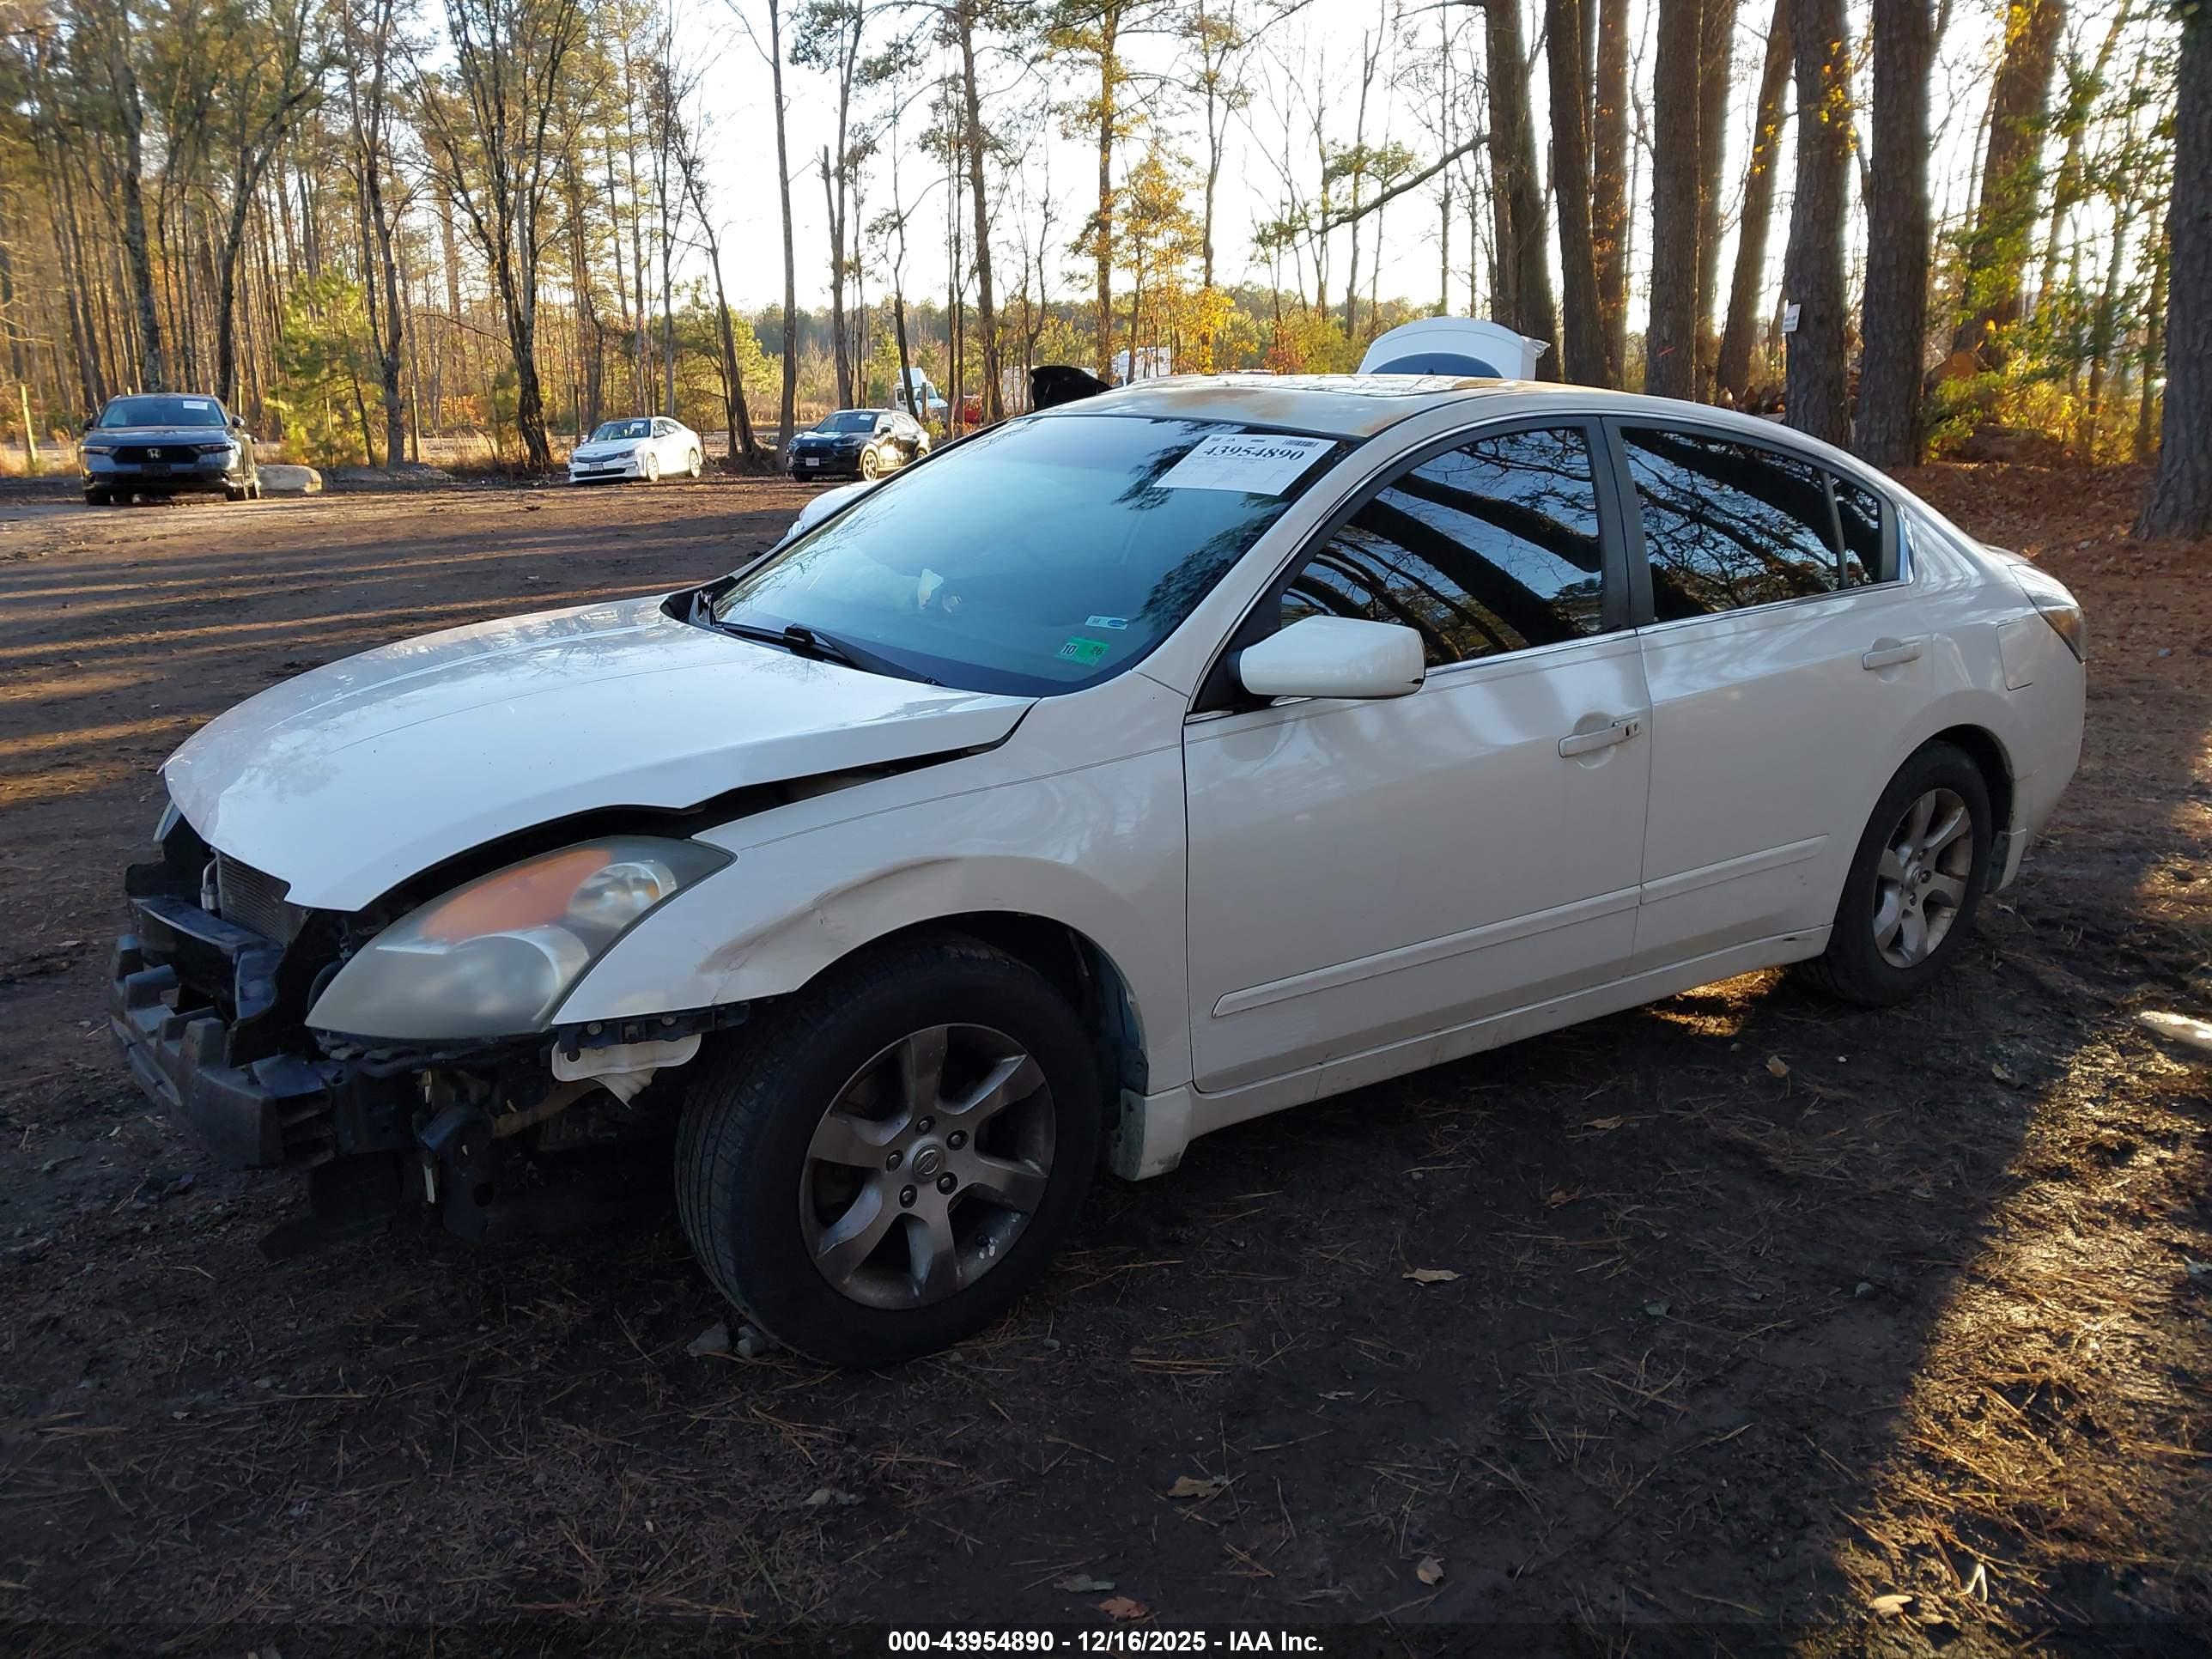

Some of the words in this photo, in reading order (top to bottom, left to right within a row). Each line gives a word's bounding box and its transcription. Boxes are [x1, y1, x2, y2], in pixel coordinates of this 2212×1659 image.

[1202, 445, 1305, 461] 43954890
[1063, 645, 1077, 654] 10
[1091, 646, 1104, 655] 26
